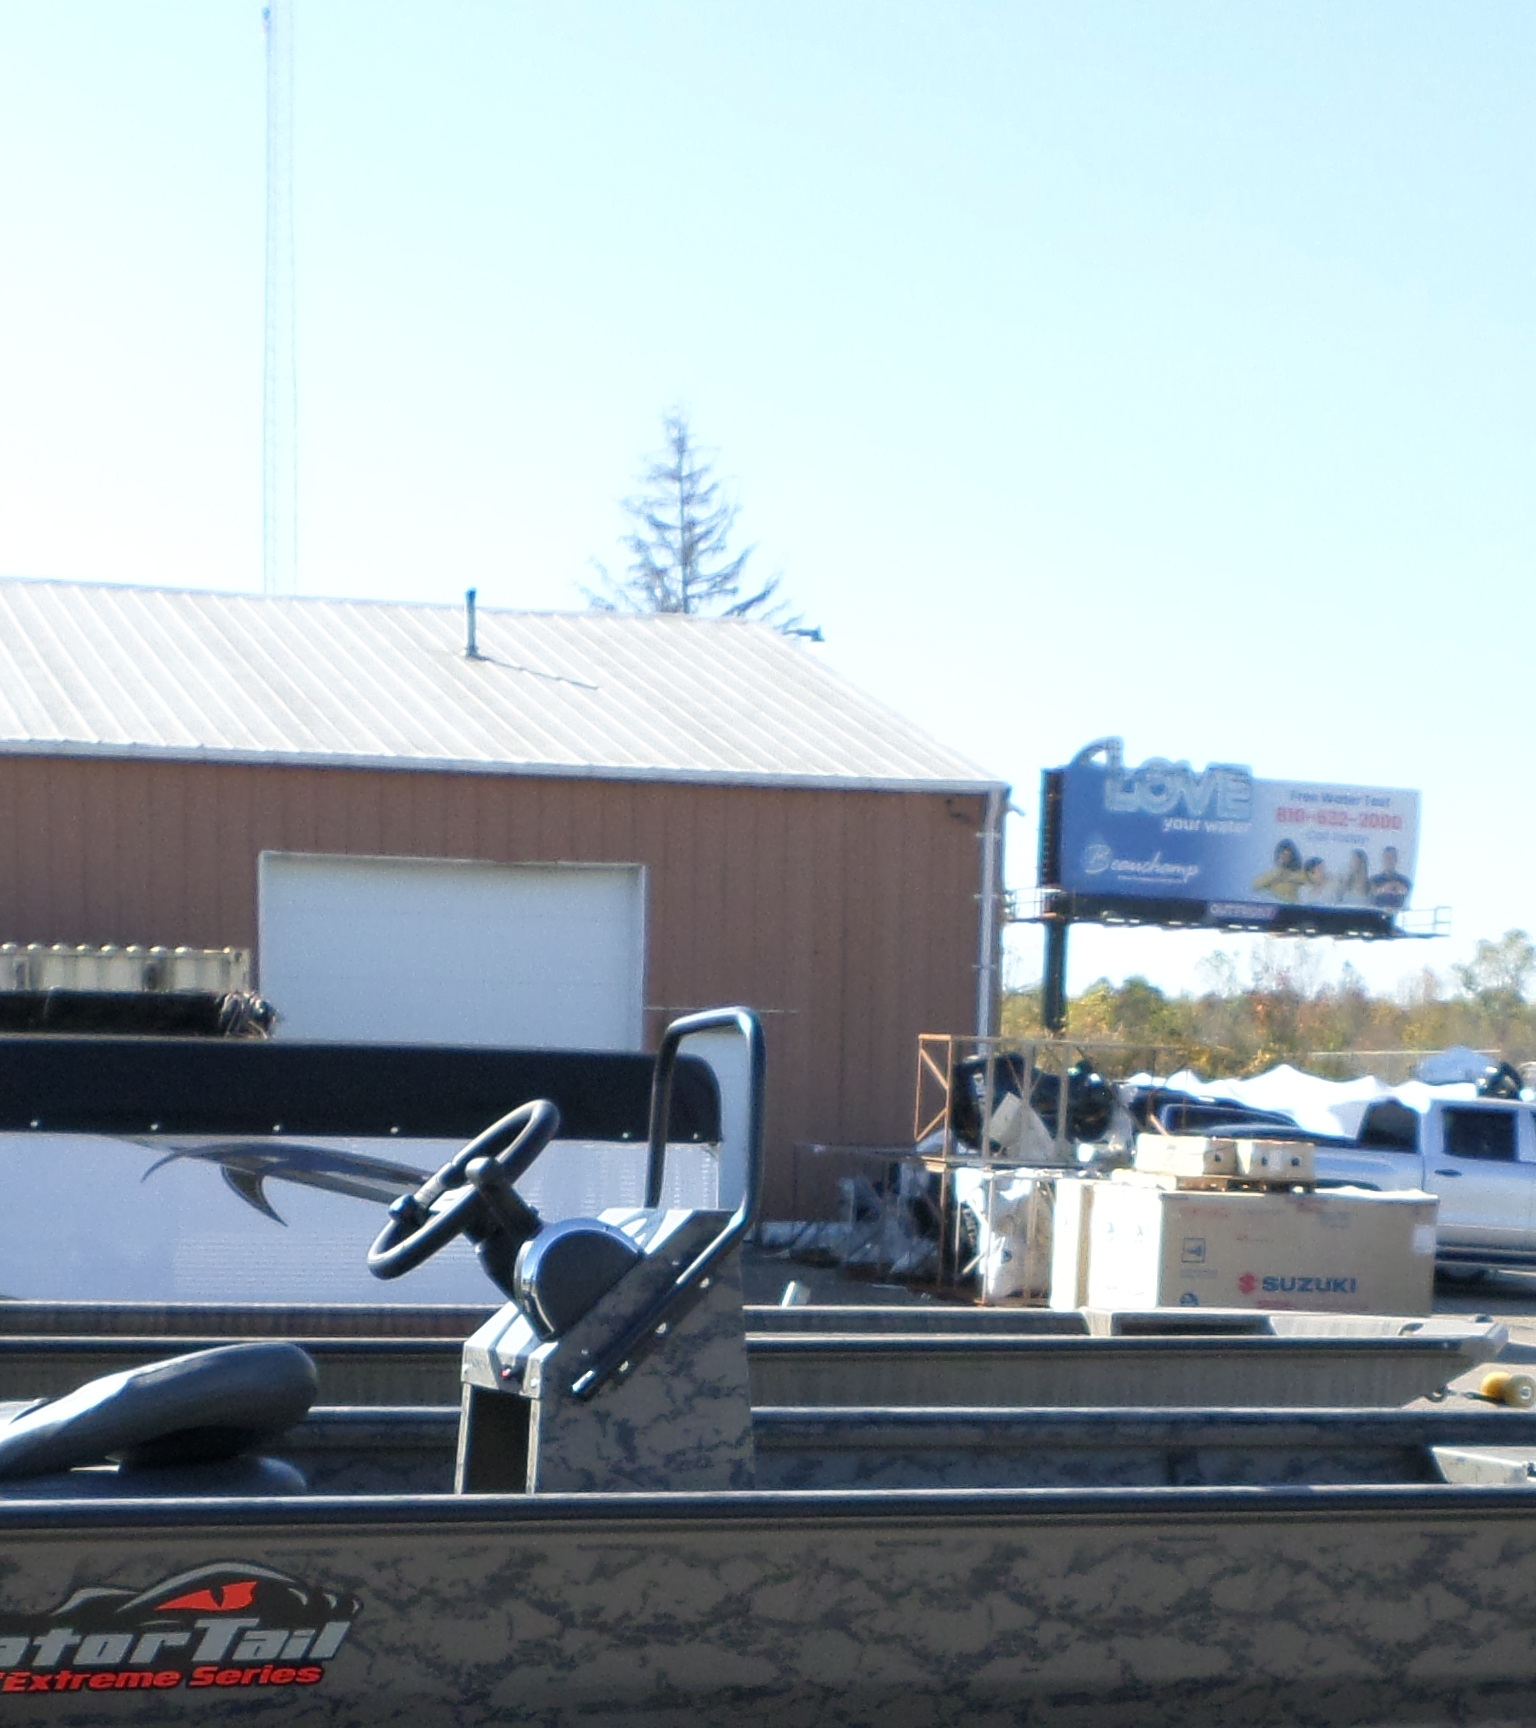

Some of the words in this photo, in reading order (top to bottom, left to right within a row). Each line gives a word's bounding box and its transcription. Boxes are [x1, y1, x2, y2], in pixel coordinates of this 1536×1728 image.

[1104, 757, 1252, 820] LOVE
[1163, 817, 1202, 832] your
[1205, 820, 1253, 833] water
[1262, 1276, 1357, 1294] SUZUKI
[1, 1667, 180, 1694] Extreme
[189, 1663, 324, 1687] Series
